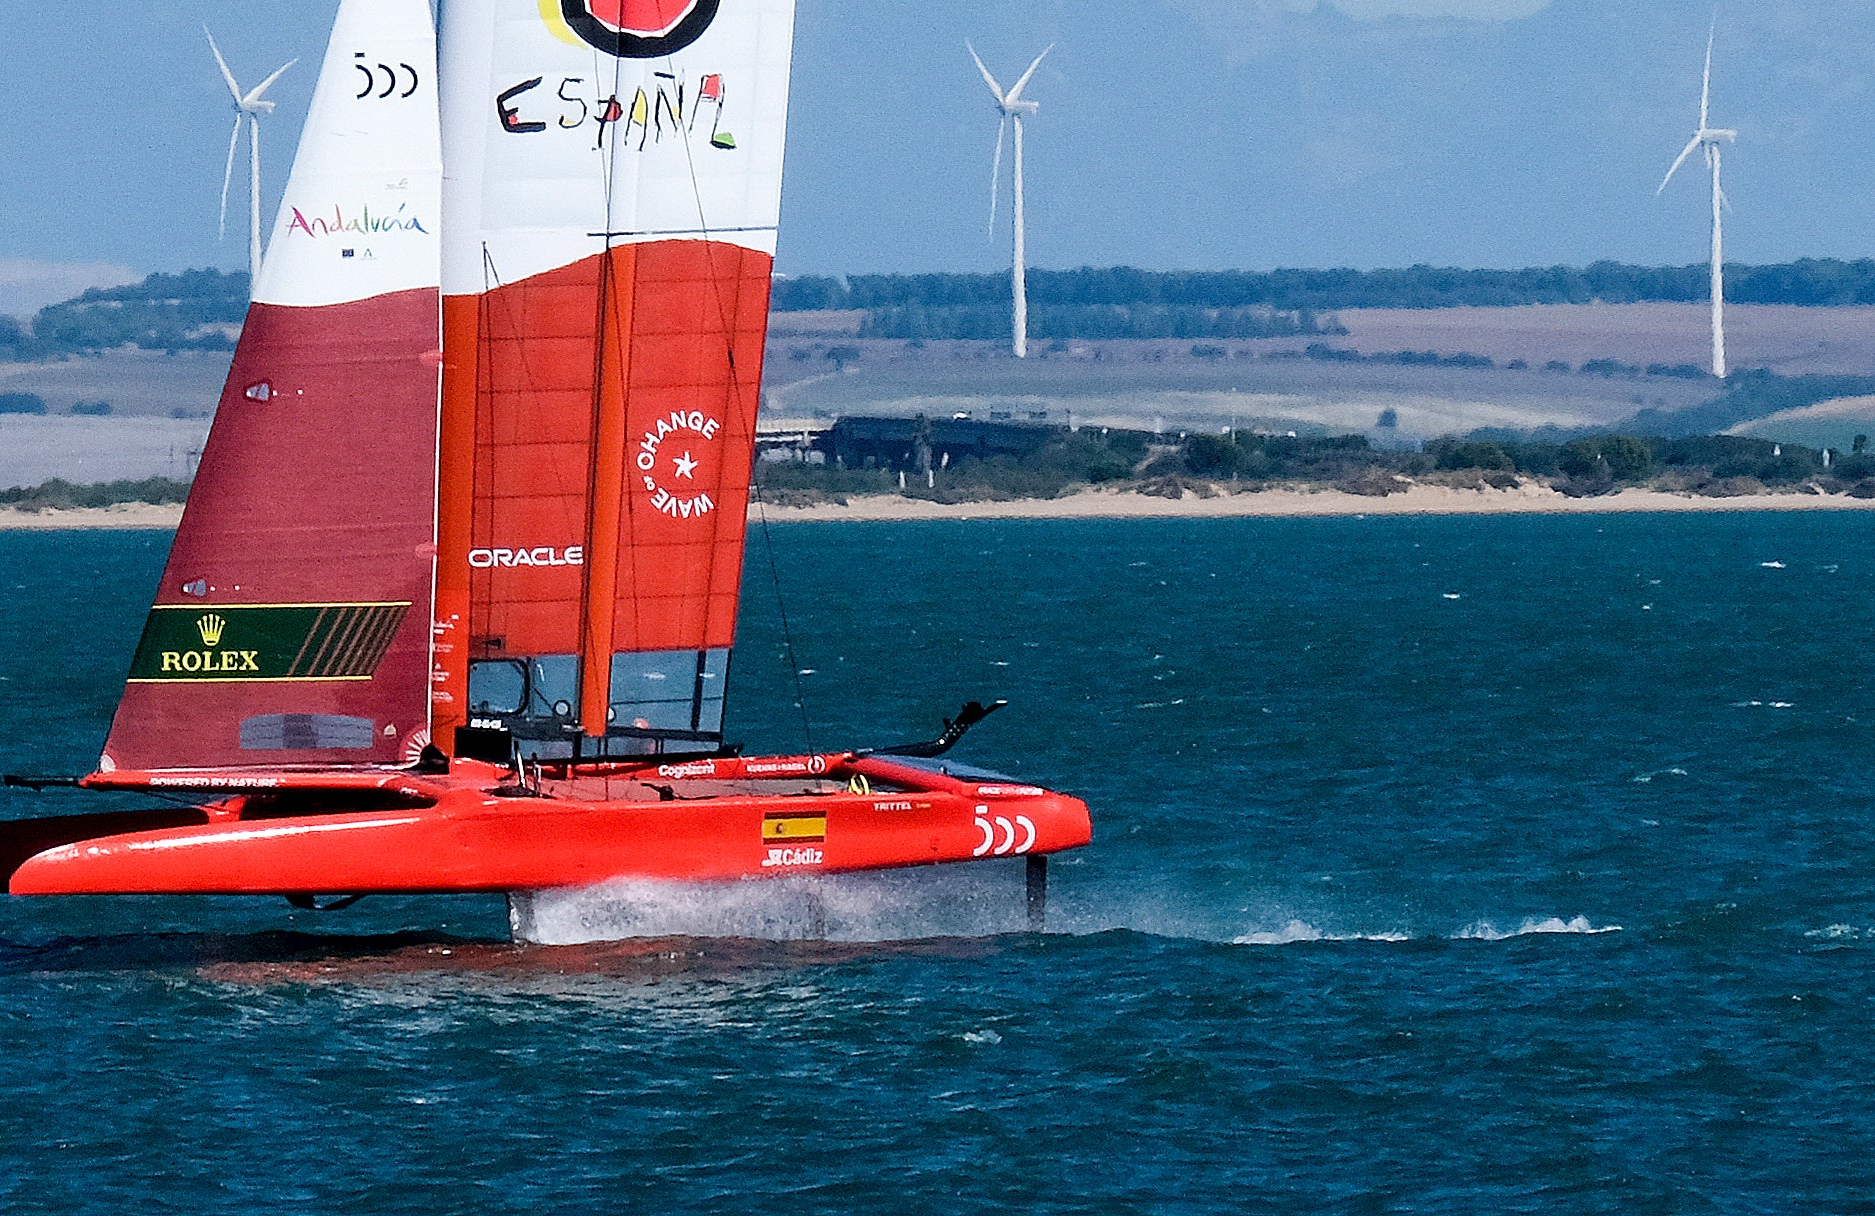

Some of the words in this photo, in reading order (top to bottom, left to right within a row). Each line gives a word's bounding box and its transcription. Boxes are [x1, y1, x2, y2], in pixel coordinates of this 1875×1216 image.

[496, 70, 737, 152] ESPAÑA
[286, 201, 430, 239] Andalucía
[649, 487, 715, 519] WAVE
[468, 546, 584, 567] ORACLE
[161, 650, 260, 672] ROLEX
[782, 847, 824, 866] Cádiz
